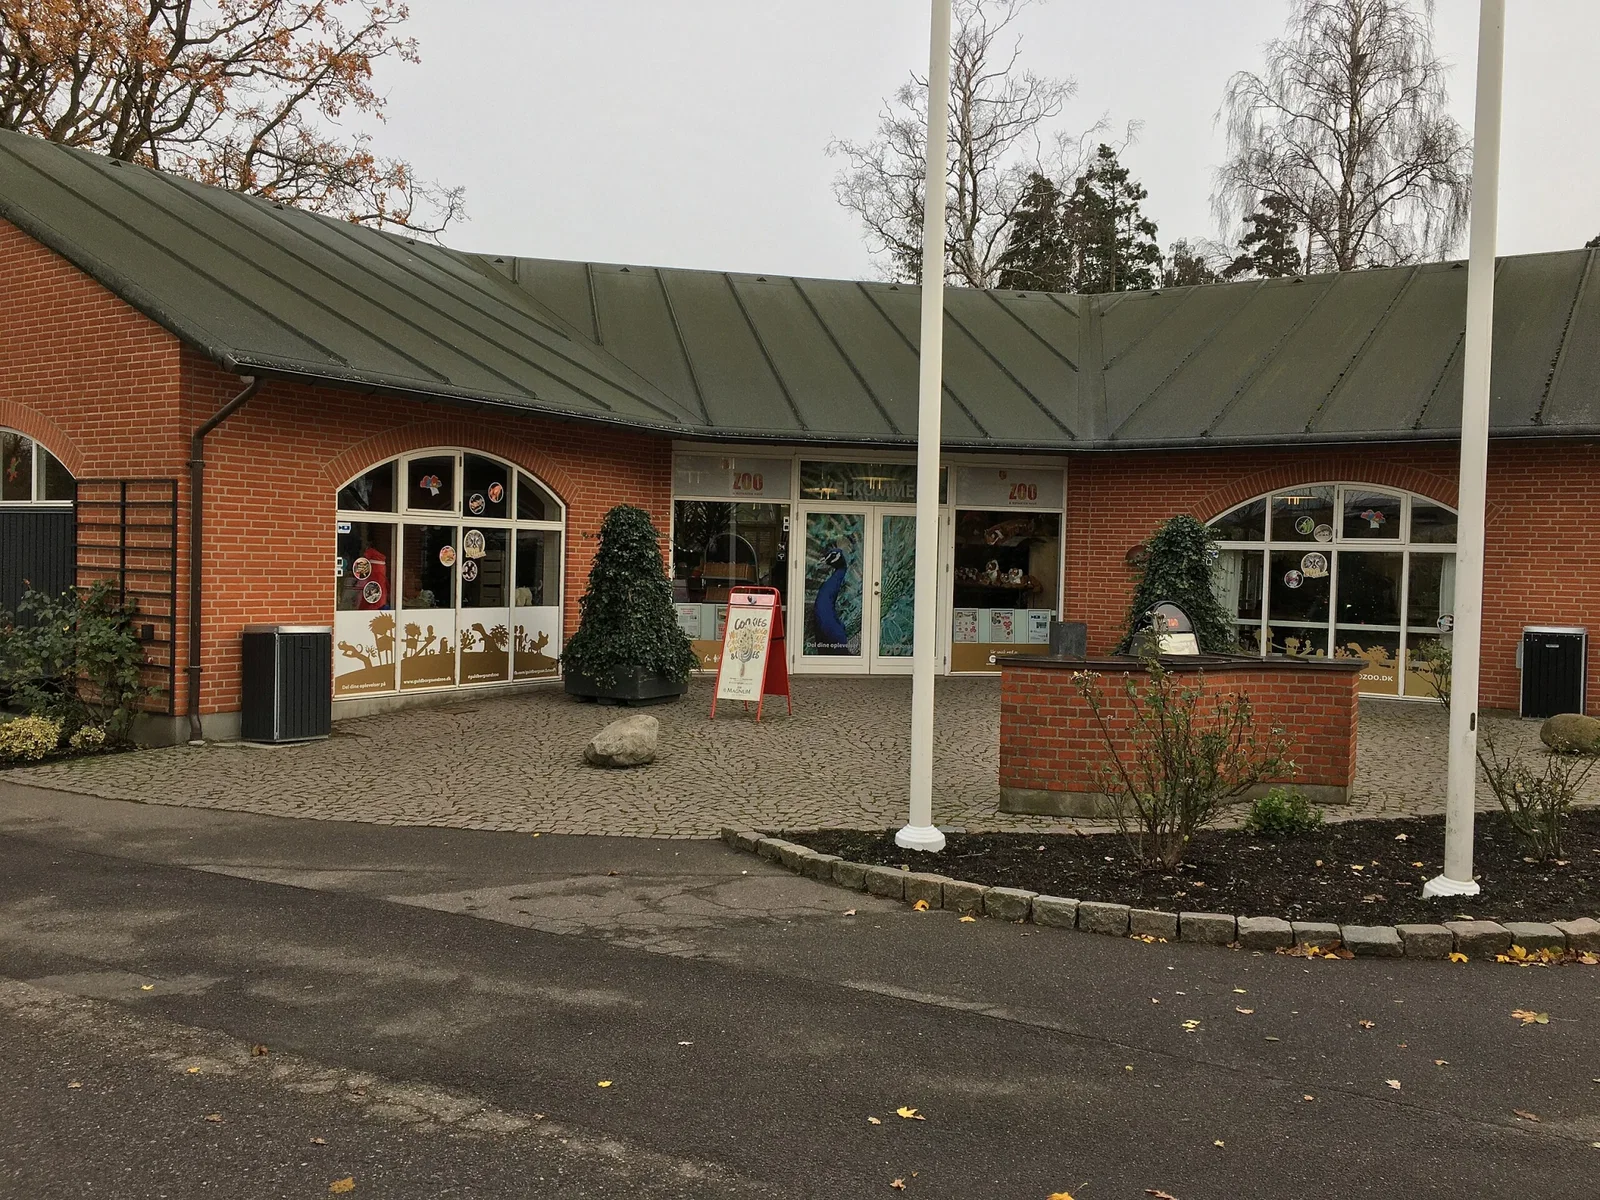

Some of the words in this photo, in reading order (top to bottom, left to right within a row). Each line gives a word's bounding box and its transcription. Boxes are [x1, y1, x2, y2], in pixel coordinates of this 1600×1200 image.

[732, 472, 764, 491] ZOO
[821, 479, 916, 499] VELKOMME
[1008, 483, 1038, 501] ZOO
